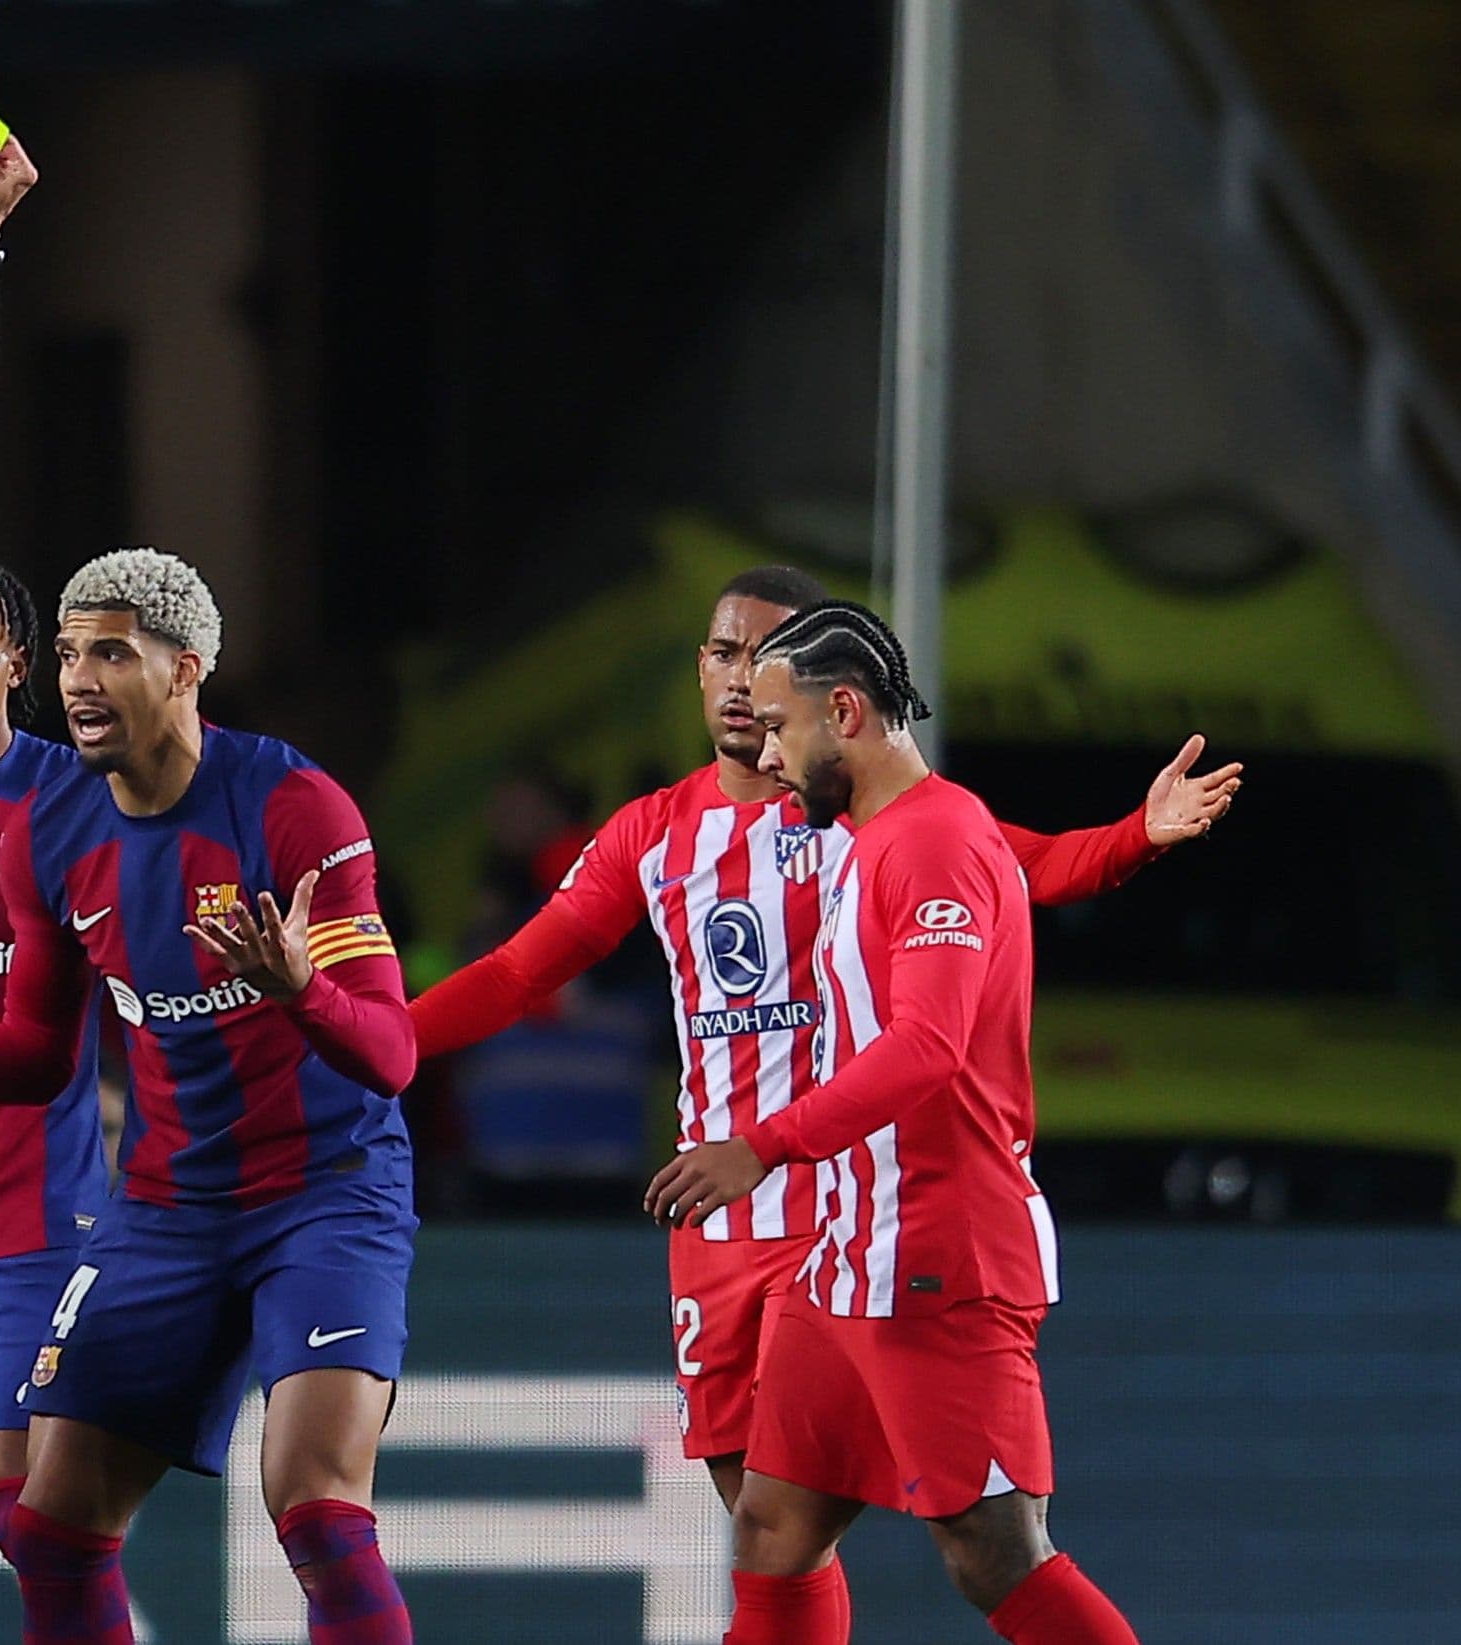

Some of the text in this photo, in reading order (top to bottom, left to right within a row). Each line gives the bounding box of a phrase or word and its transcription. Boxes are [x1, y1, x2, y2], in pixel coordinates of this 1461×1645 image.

[903, 931, 984, 952] HYUNDAI
[145, 977, 262, 1023] Spotify
[691, 1002, 812, 1038] RIYADH AIR
[51, 1264, 100, 1340] 4
